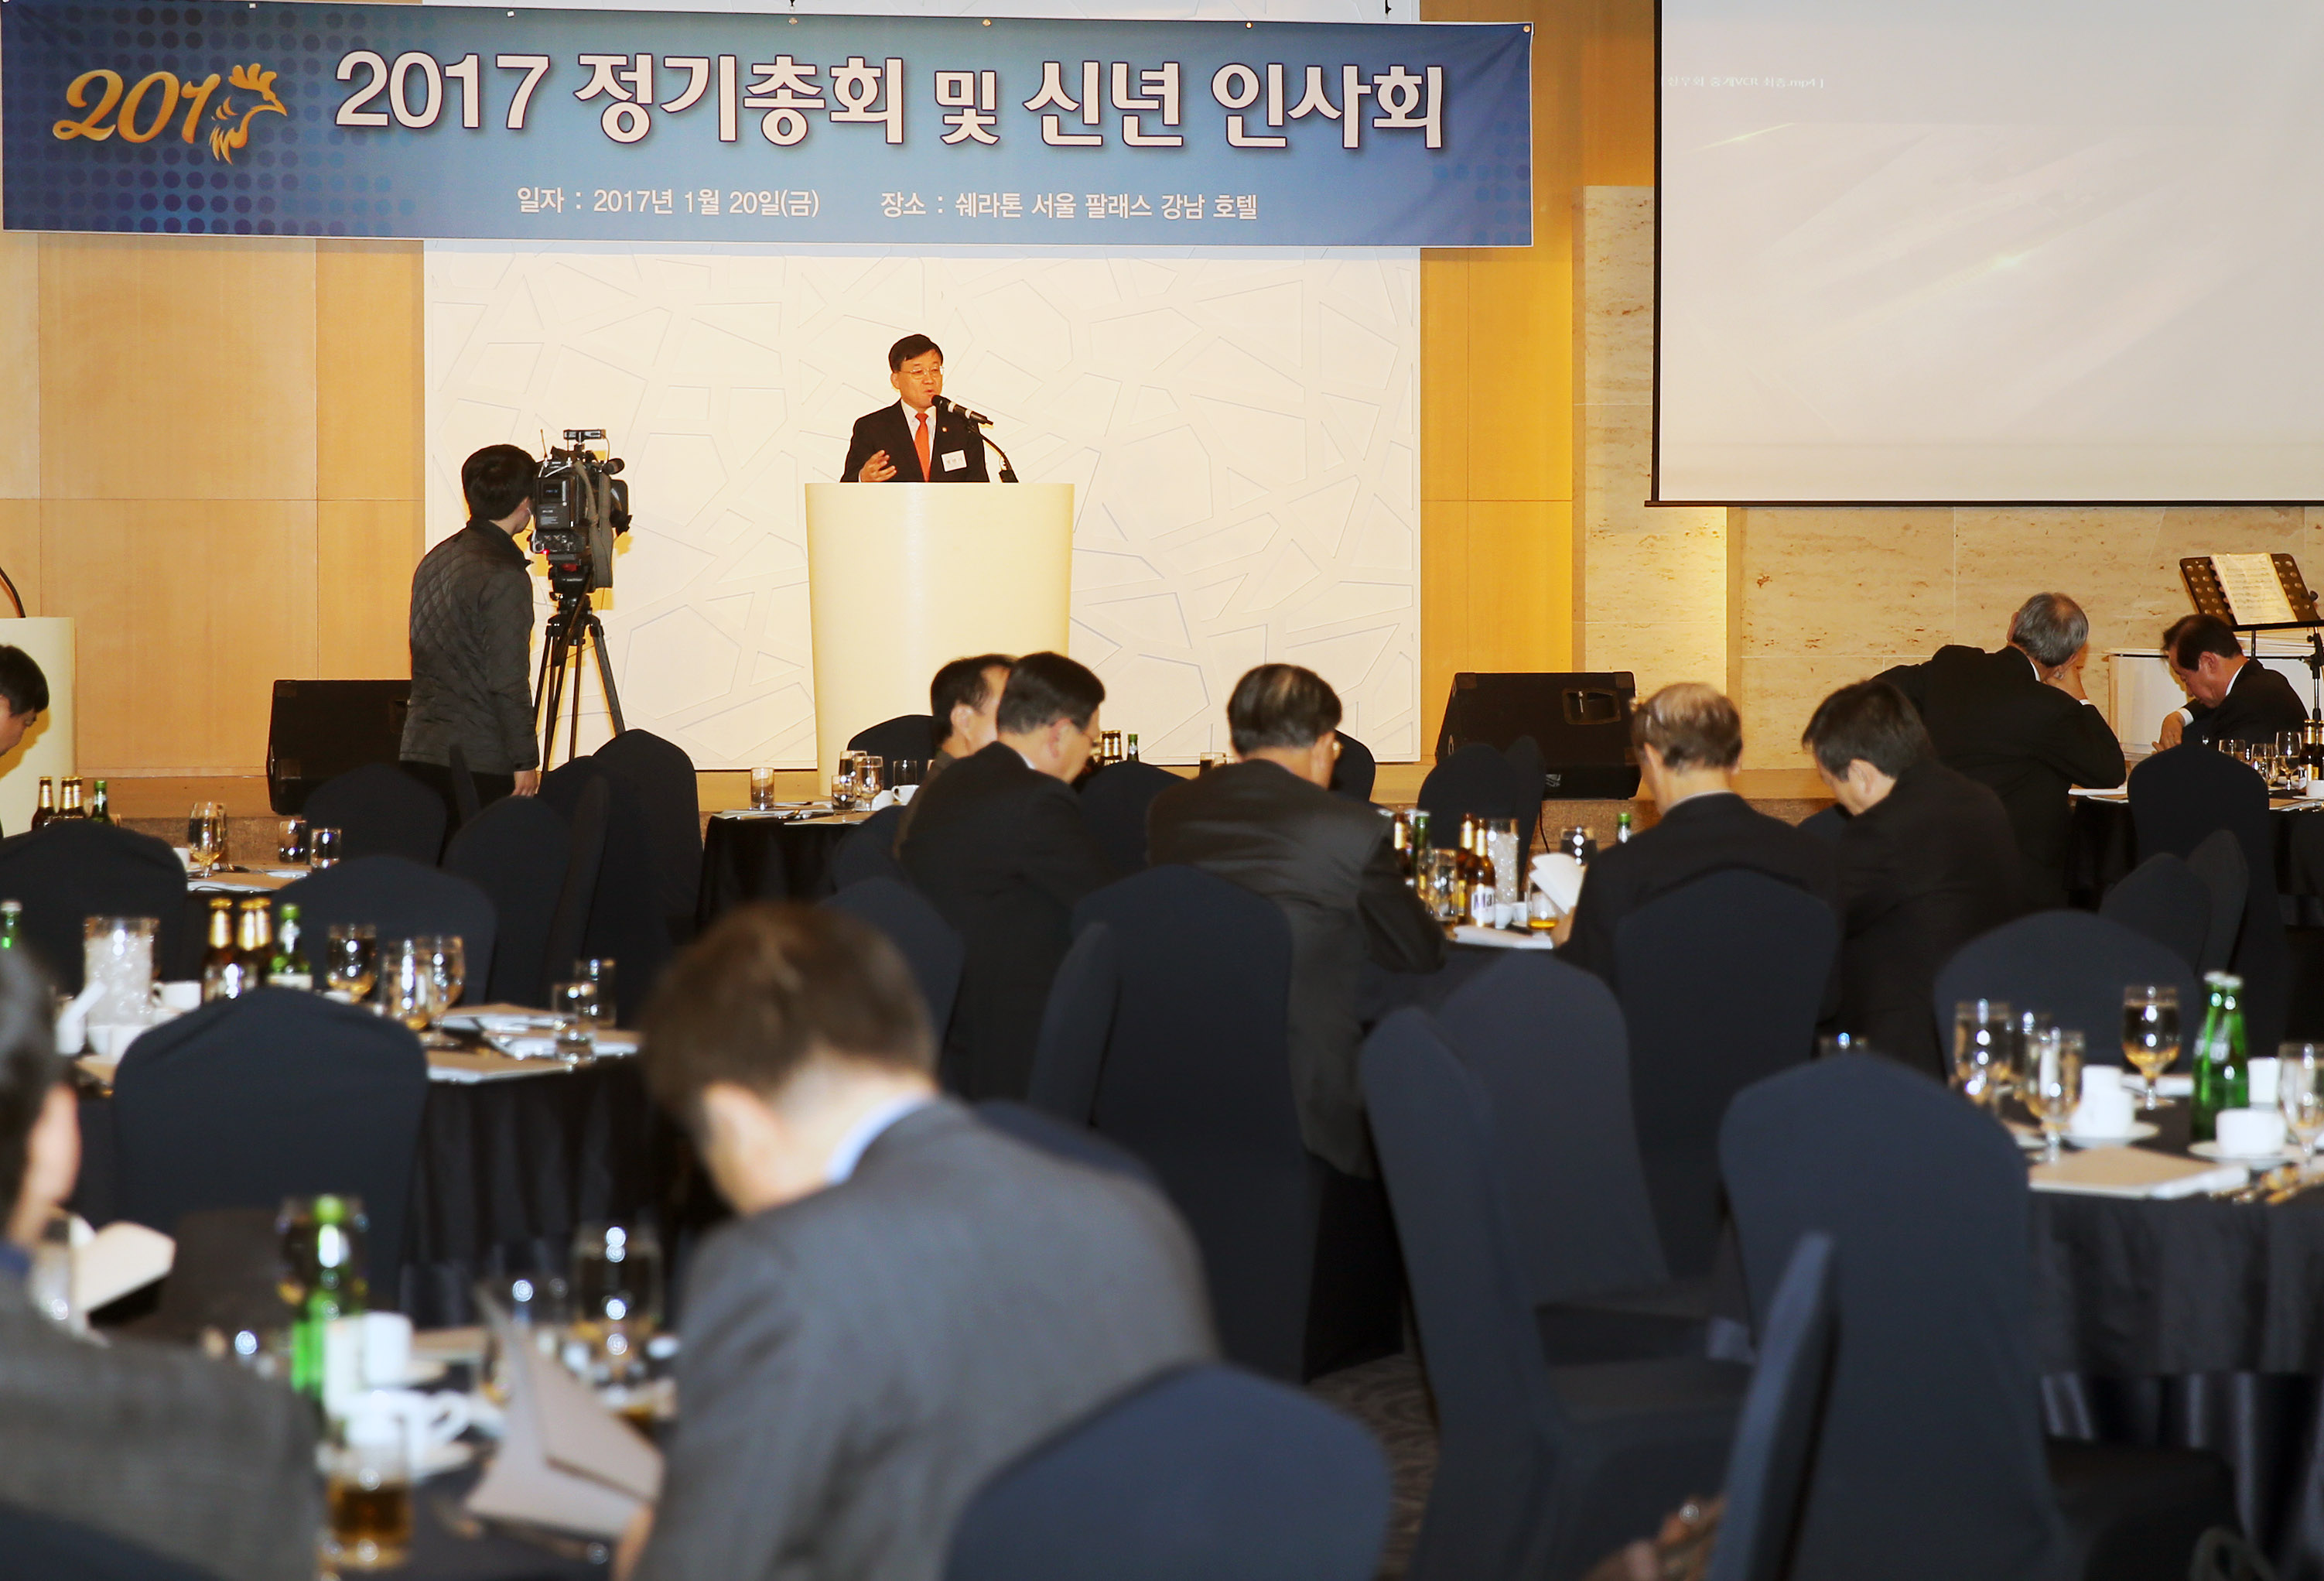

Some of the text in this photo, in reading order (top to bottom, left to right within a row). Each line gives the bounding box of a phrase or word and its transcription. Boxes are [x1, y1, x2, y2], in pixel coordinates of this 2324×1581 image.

[333, 49, 1444, 150] 2017 정기총회 및 신년 인사회
[517, 187, 565, 214] 일자
[593, 188, 673, 215] 2017년
[685, 189, 719, 216] 1월
[729, 189, 820, 218] 20일(금)
[880, 191, 927, 217] 장소
[955, 192, 1023, 219] 쉐라톤
[1031, 193, 1077, 219] 서울
[1085, 193, 1153, 219] 팔래스
[1160, 193, 1205, 220] 강남
[1212, 194, 1258, 221] 호텔
